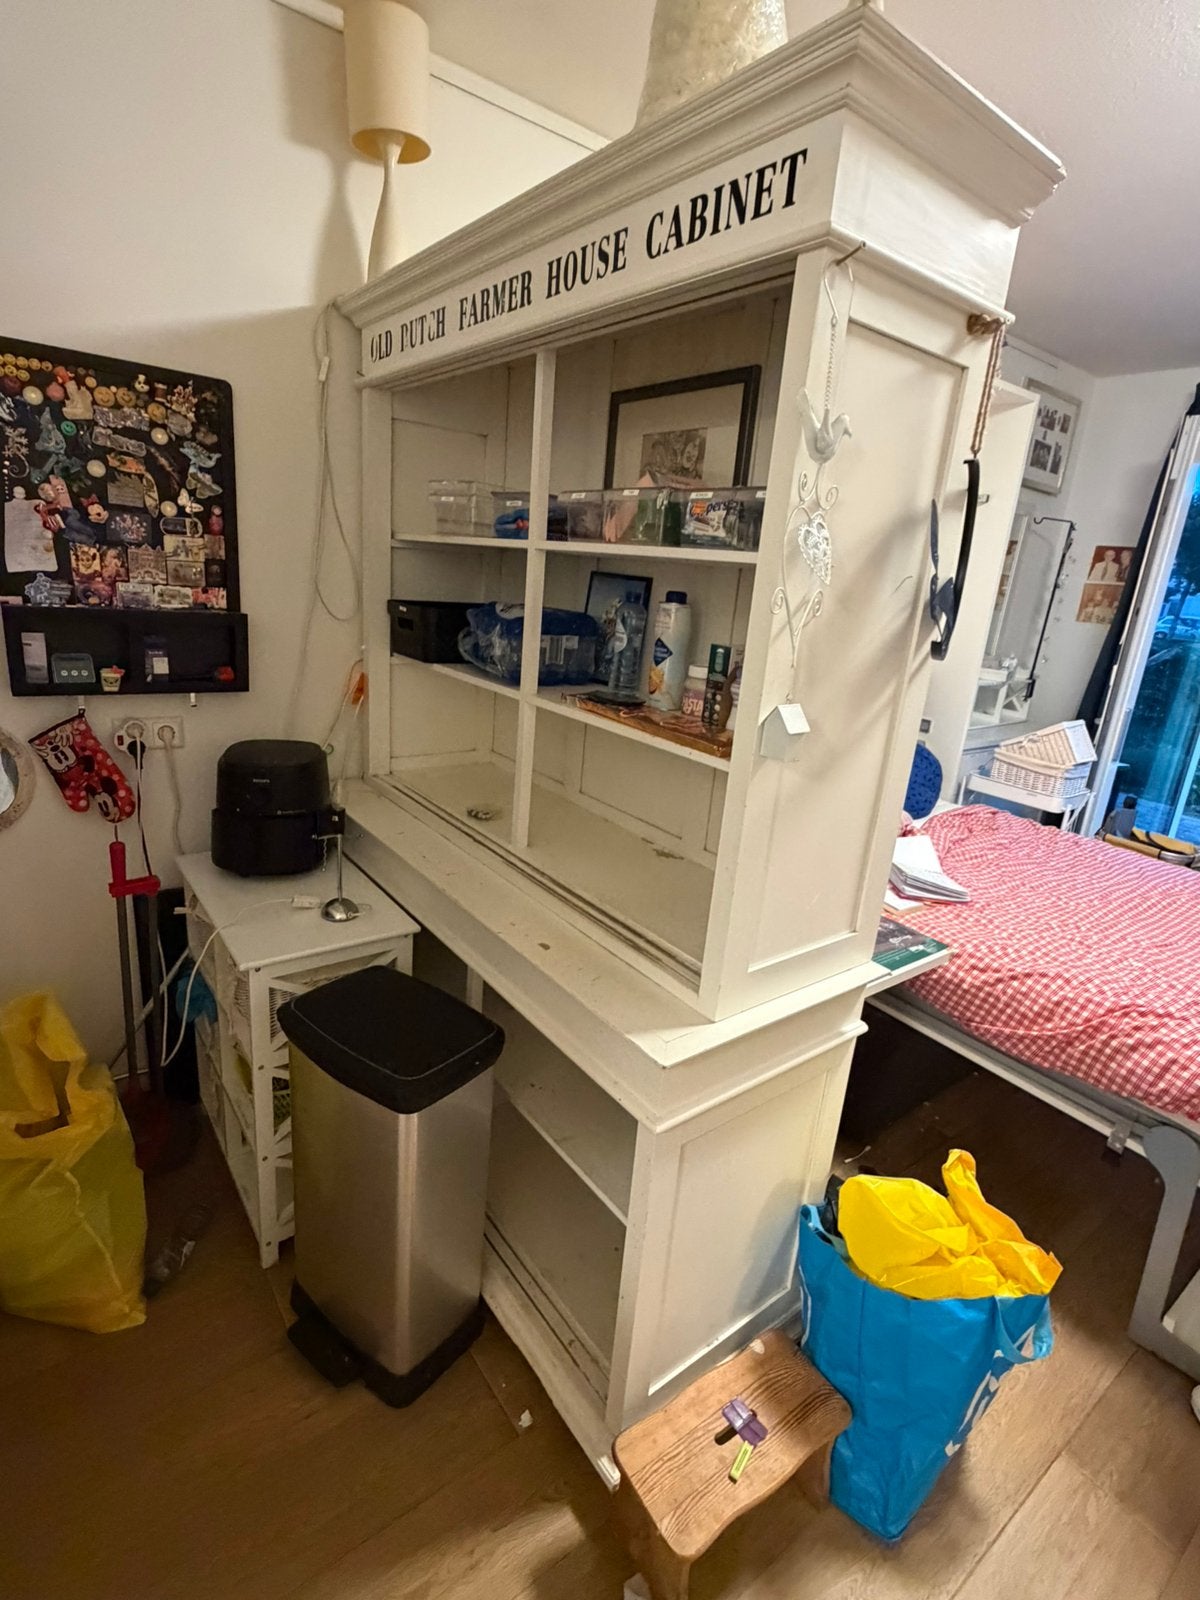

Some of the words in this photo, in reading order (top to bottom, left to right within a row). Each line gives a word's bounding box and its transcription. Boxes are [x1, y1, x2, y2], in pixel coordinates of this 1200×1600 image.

[370, 330, 393, 363] OLD
[459, 270, 533, 331] FARMER
[545, 226, 629, 300] HOUSE
[646, 148, 808, 260] CABINET
